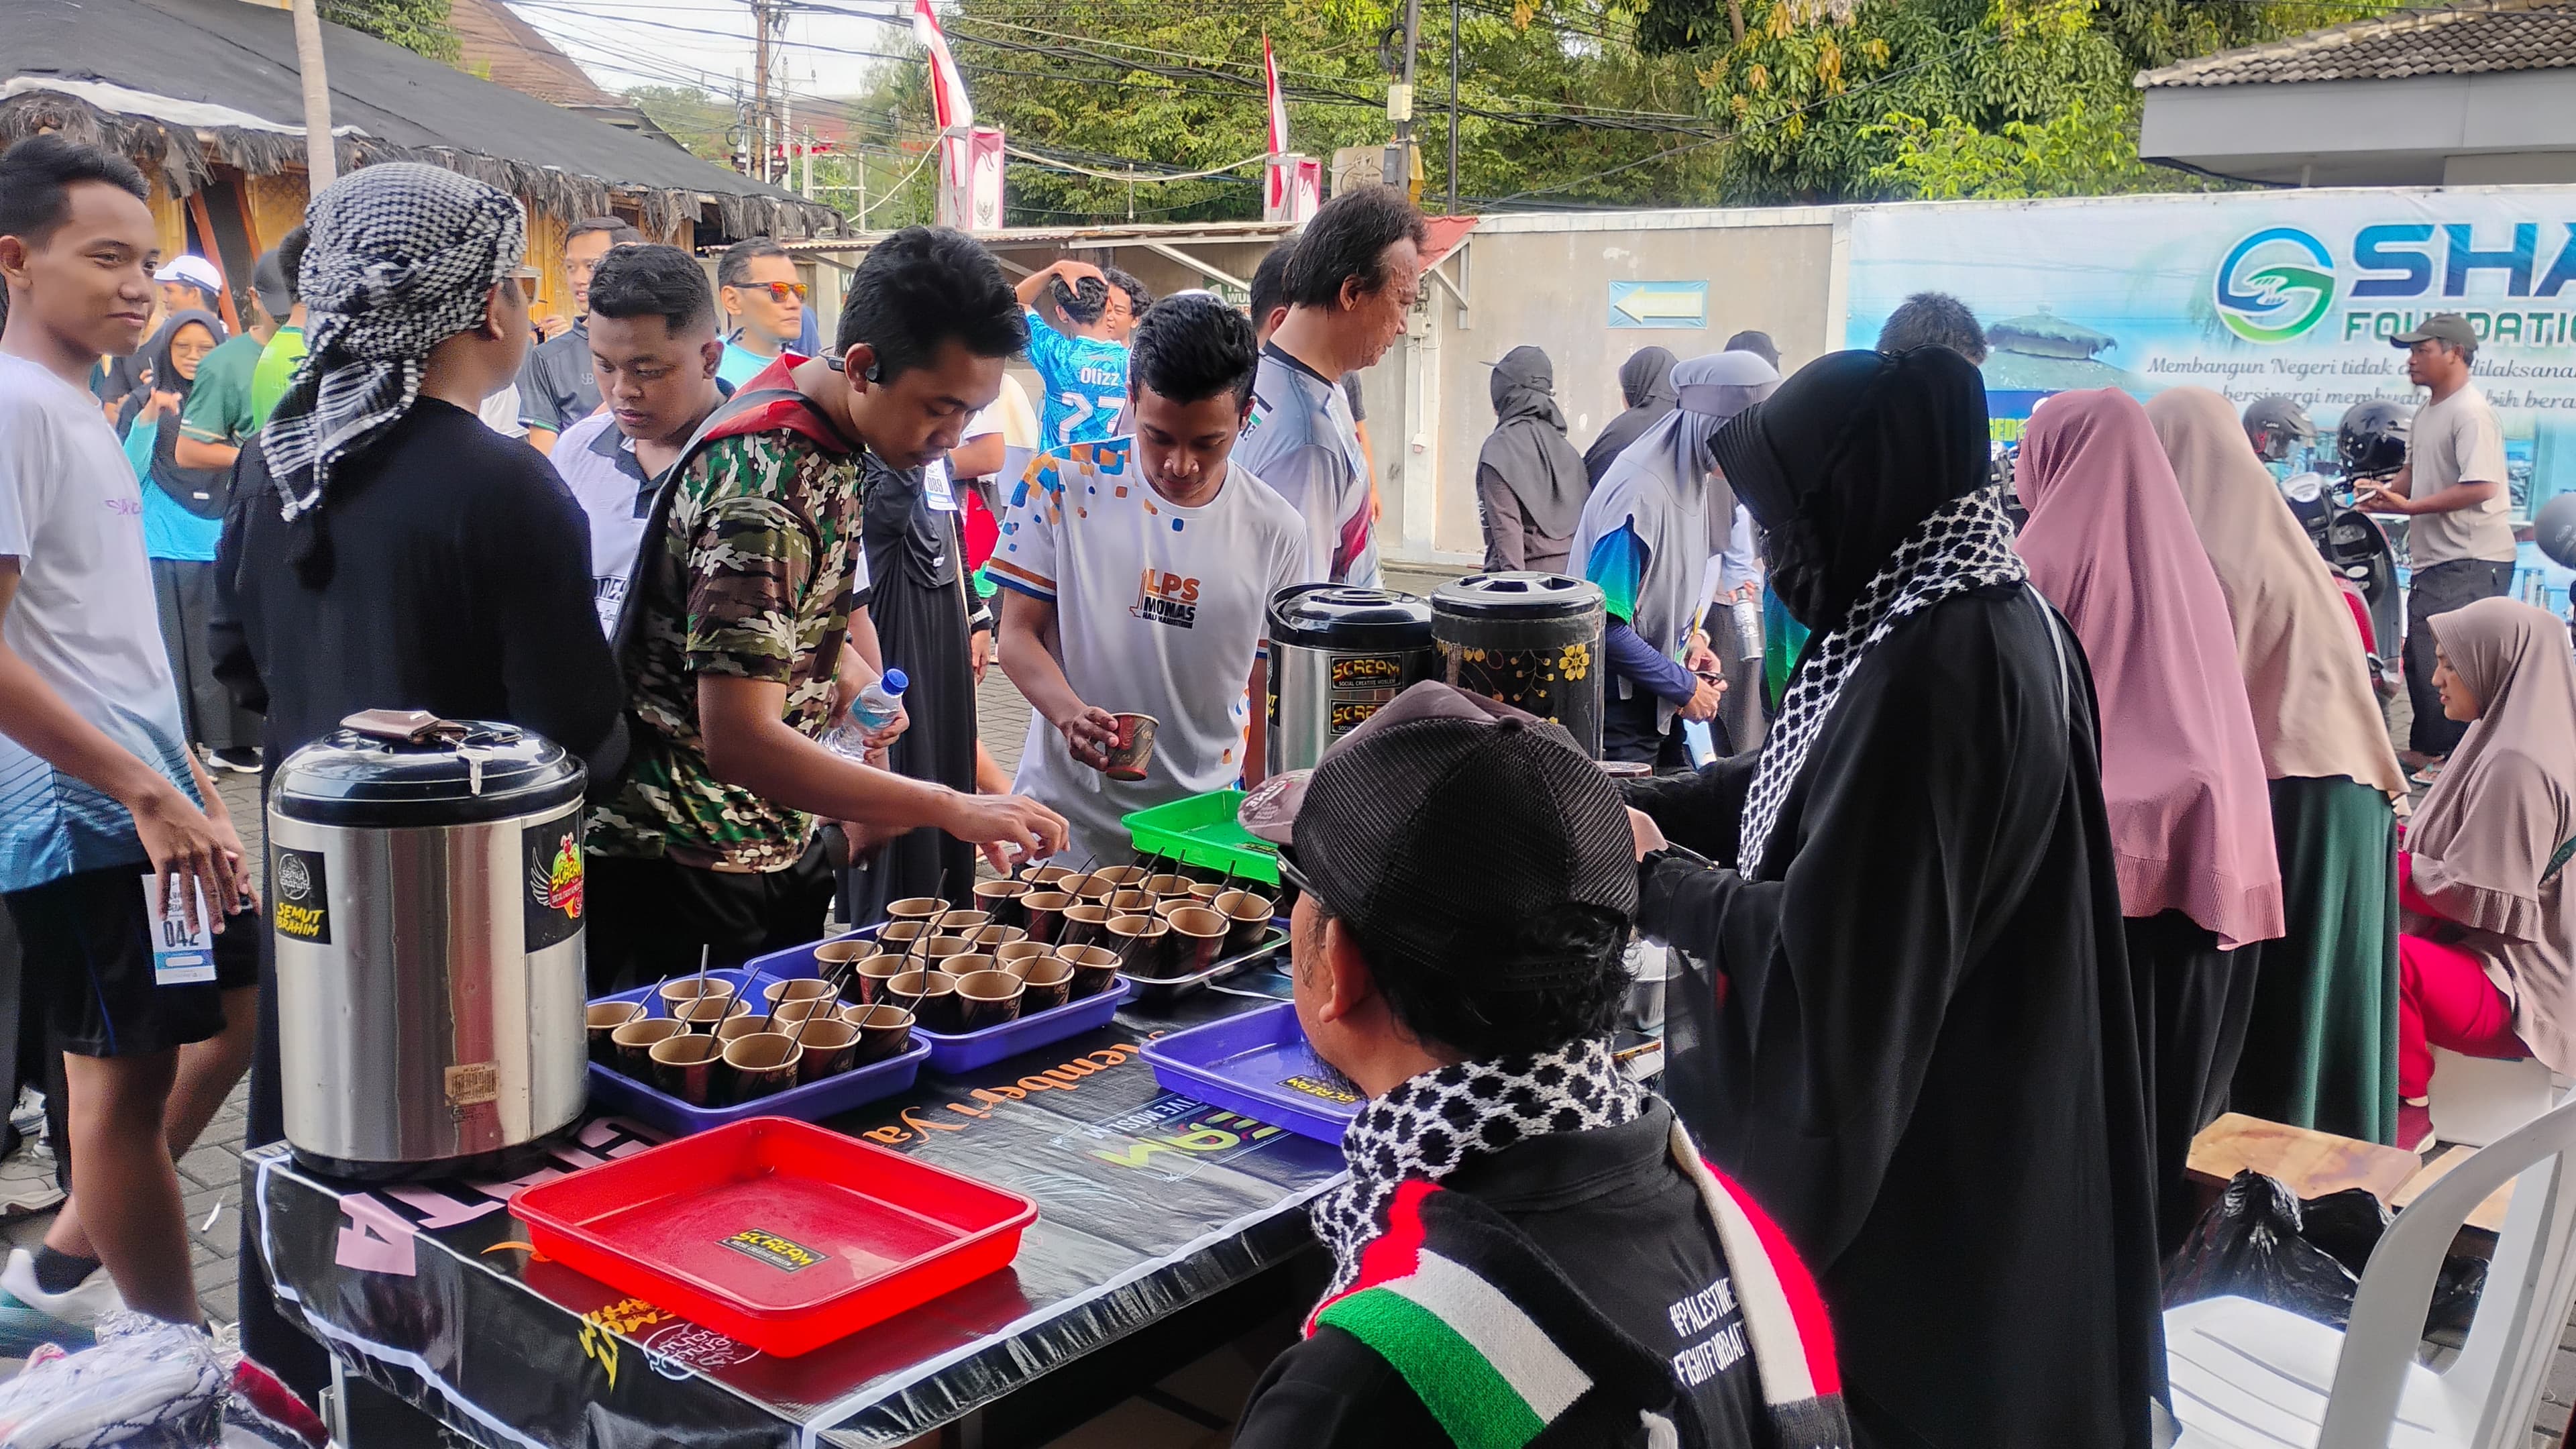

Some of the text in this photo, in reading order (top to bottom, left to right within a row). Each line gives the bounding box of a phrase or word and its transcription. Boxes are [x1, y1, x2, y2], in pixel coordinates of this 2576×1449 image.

[2344, 312, 2576, 344] FODATI
[1080, 367, 1120, 386] Olizz
[2147, 356, 2265, 380] Membangun
[2271, 358, 2336, 381] Negeri
[2341, 357, 2392, 376] tidak
[1059, 391, 1127, 444] 27
[1147, 568, 1201, 601] LPS
[1143, 596, 1196, 621] MONAS
[1332, 659, 1400, 681] SCREAM
[277, 902, 326, 924] SEMUT
[276, 915, 320, 937] IBRAHIM
[1286, 1077, 1357, 1102] SCREAM
[731, 1232, 814, 1266] SCREAM
[731, 1240, 794, 1267] SOCIAL CREATIVE MOSLEM
[1669, 1277, 1739, 1338] #PALESTINE
